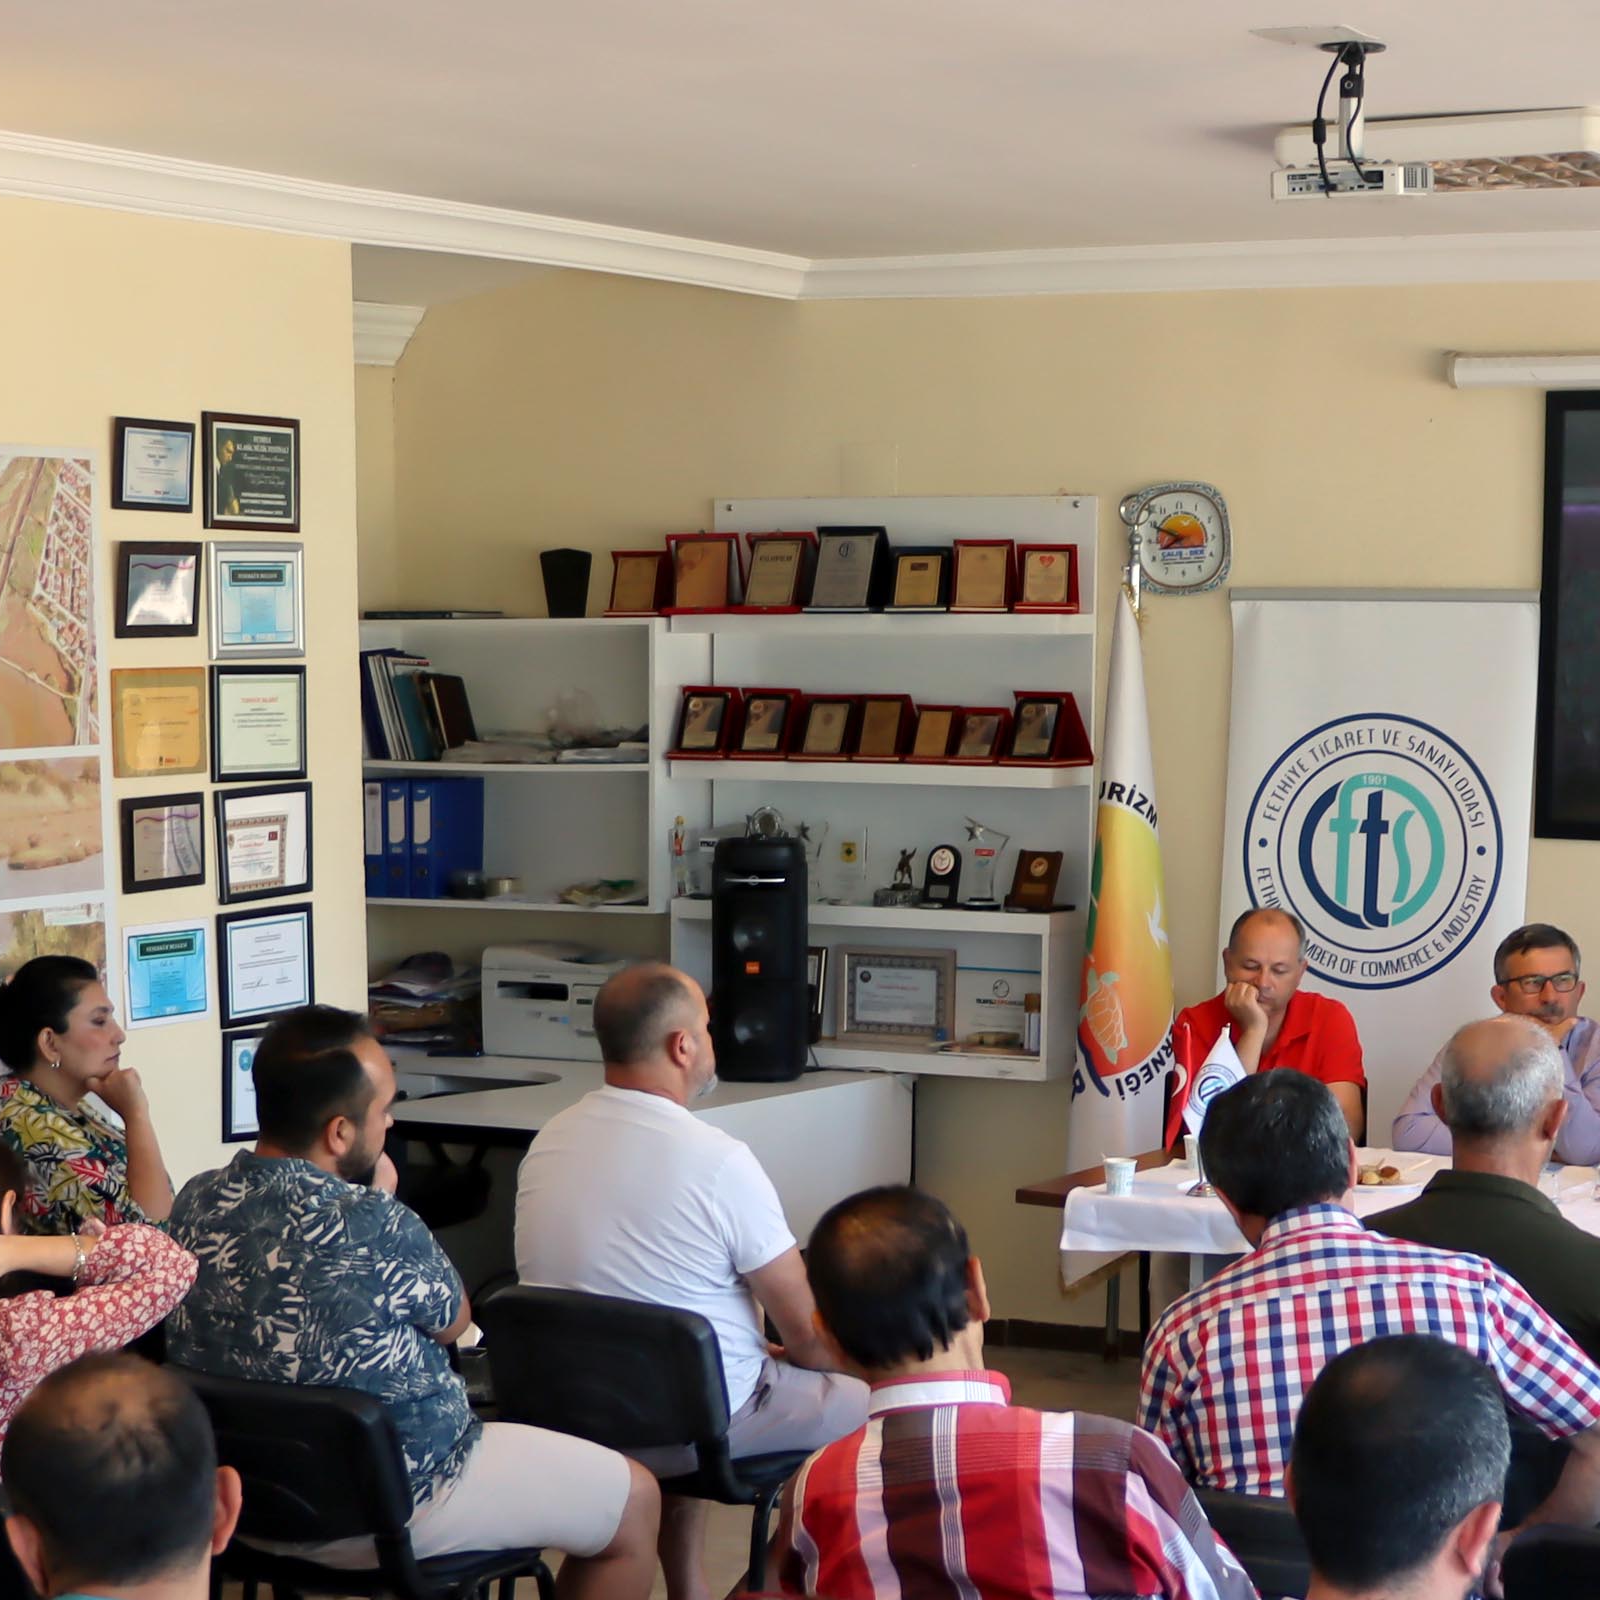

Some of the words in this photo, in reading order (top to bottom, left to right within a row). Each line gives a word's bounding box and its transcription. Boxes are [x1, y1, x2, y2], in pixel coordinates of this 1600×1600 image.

[1099, 781, 1158, 829] URİZM
[1263, 758, 1309, 821] FETHİYE
[1309, 728, 1374, 763] TİCARET
[1382, 728, 1401, 746] VE
[1408, 735, 1460, 780] SANAYİ
[1454, 776, 1486, 829] ODASI
[1361, 774, 1388, 786] 1901
[1256, 867, 1283, 909] FETHI
[1302, 938, 1338, 969] MBER
[1340, 958, 1356, 974] OF
[1361, 943, 1434, 977] COMMERCE
[1441, 874, 1486, 943] INDUSTRY
[1115, 1037, 1173, 1101] RNEĞİ
